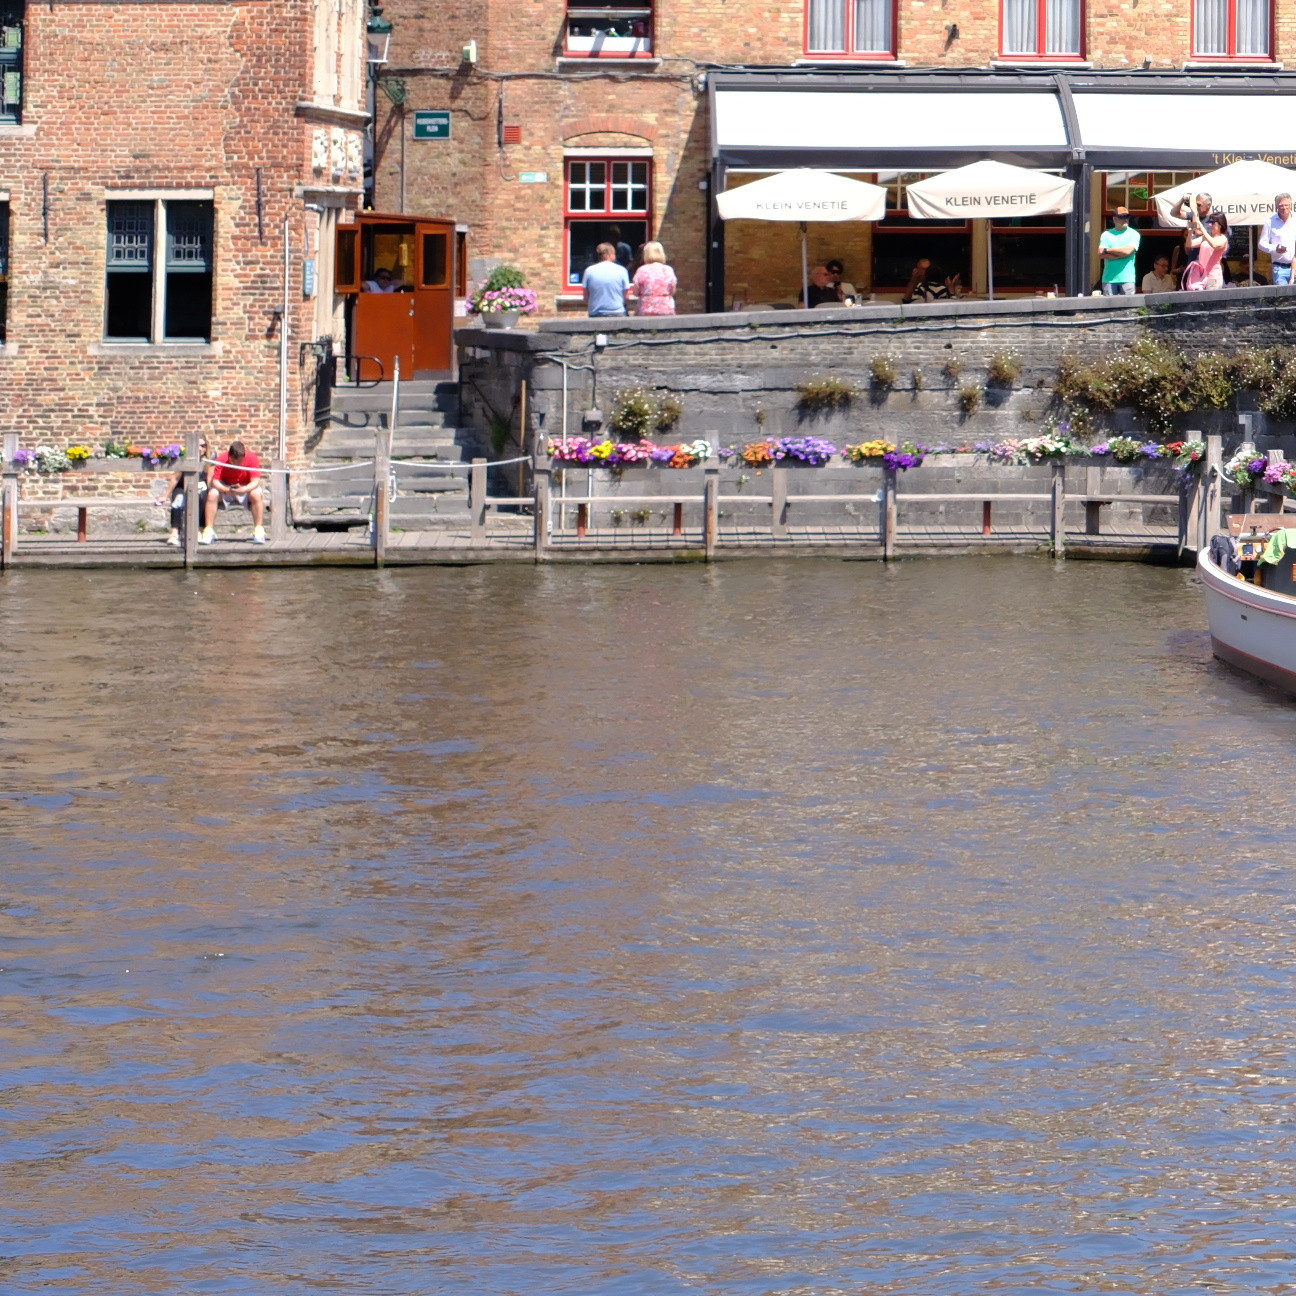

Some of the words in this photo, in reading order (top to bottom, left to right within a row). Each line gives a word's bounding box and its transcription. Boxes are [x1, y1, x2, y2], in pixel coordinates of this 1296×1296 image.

[756, 202, 792, 210] KLEIN
[796, 200, 848, 210] VENETIË
[945, 196, 981, 207] KLEIN
[985, 193, 1037, 206] VENETIË
[1212, 204, 1247, 214] KLEIN
